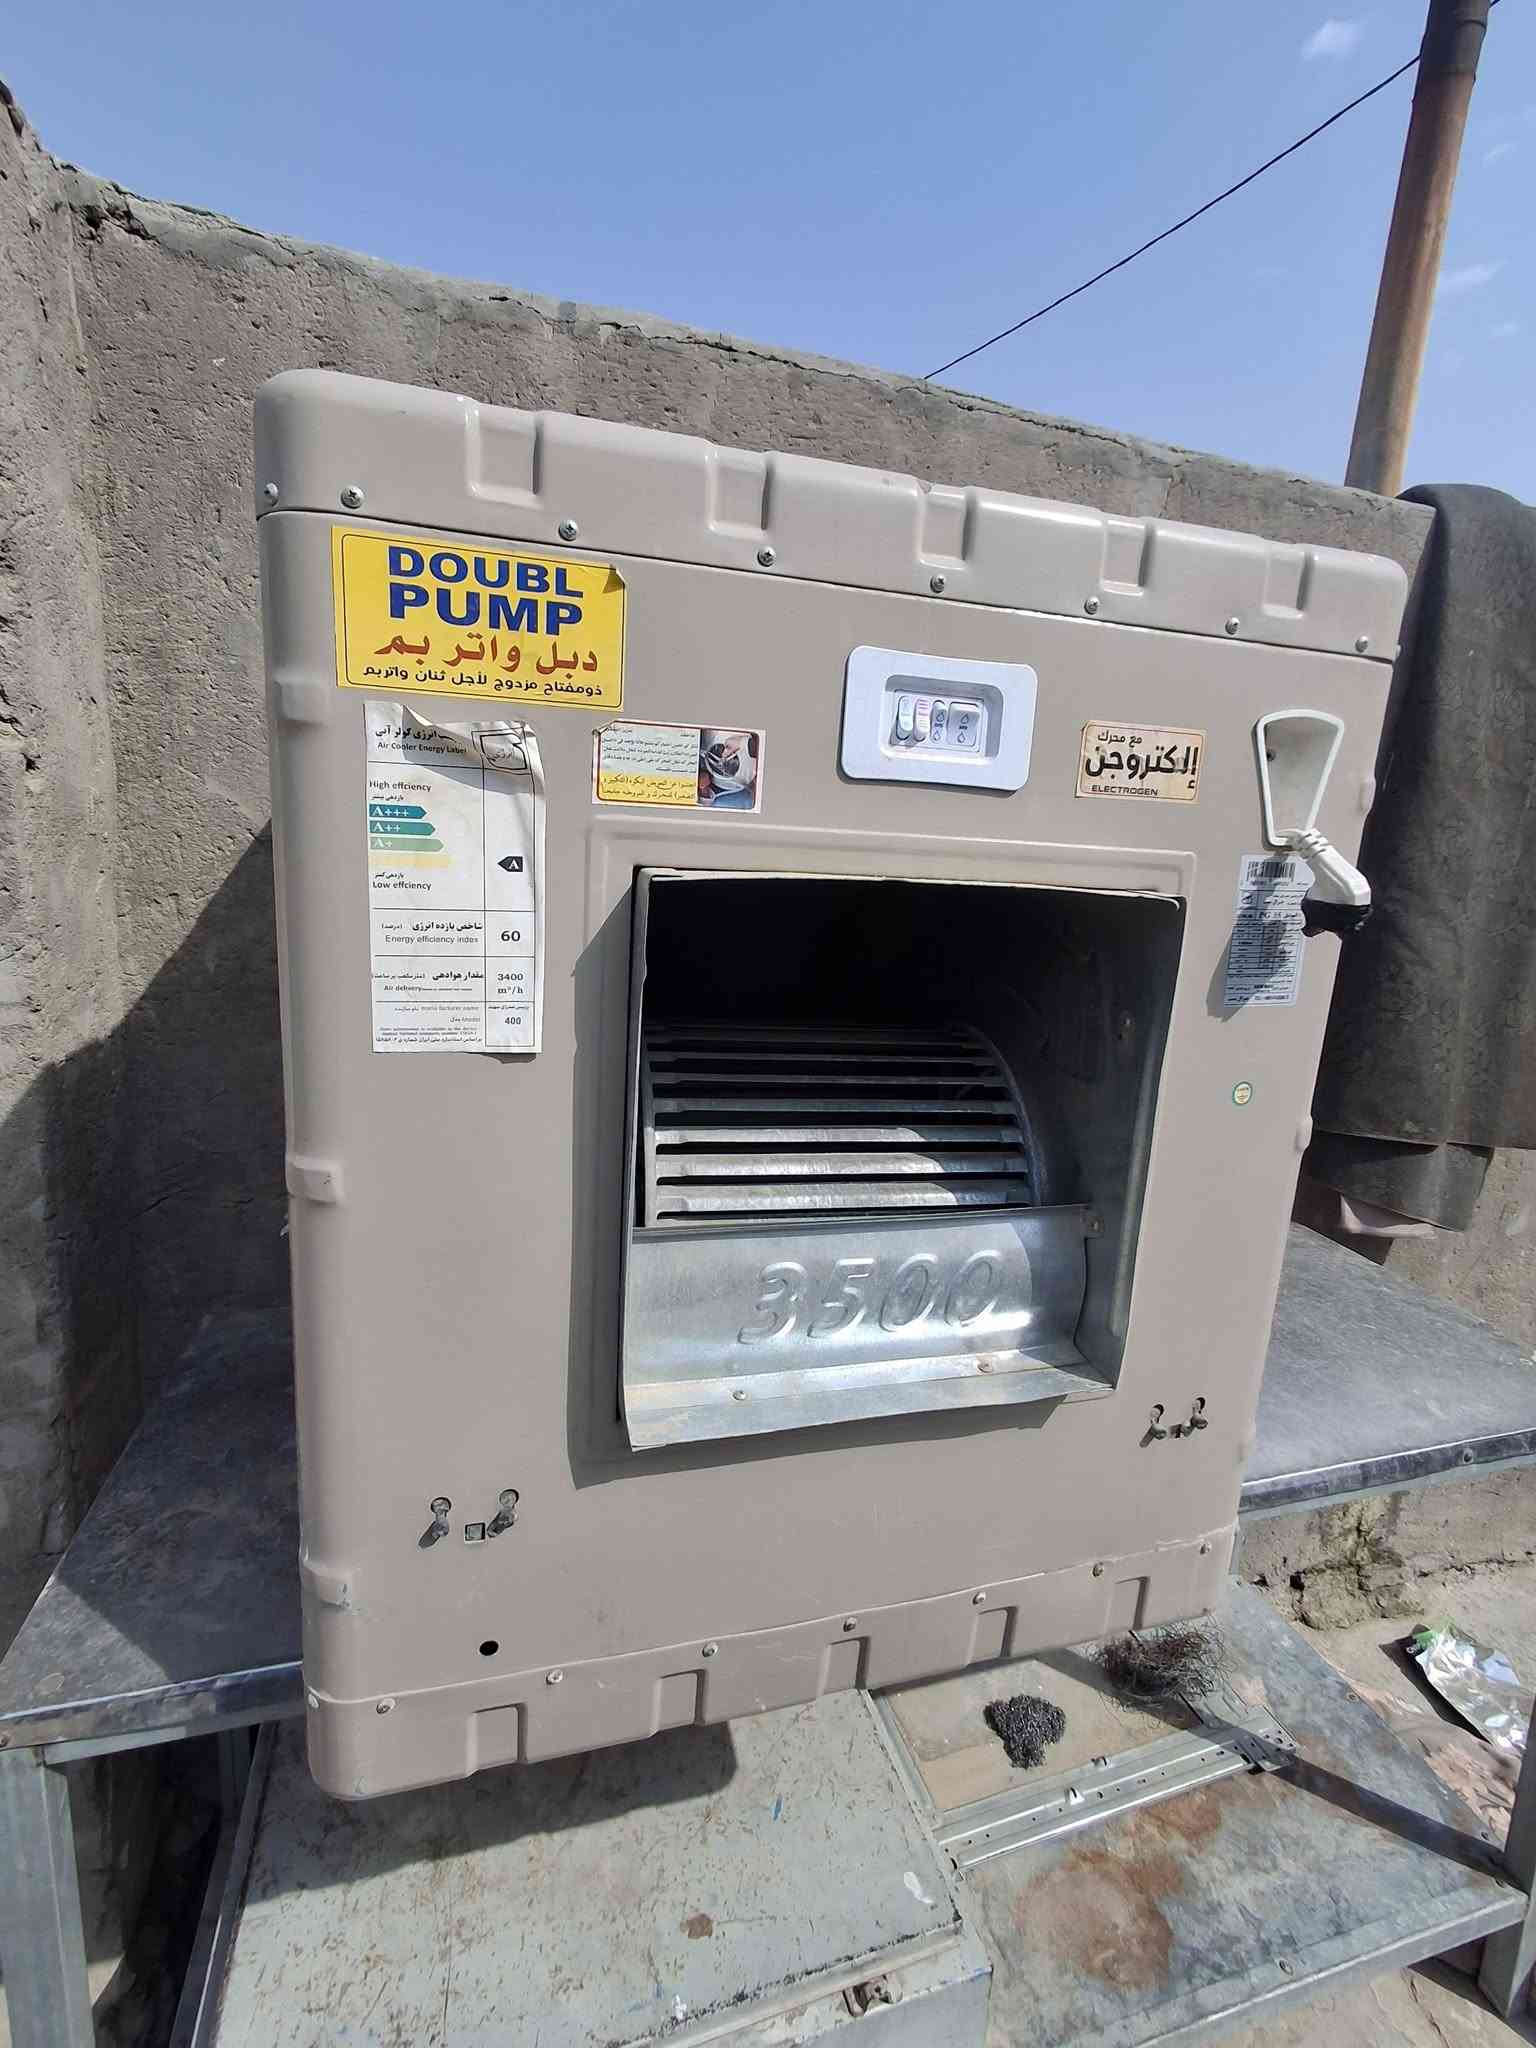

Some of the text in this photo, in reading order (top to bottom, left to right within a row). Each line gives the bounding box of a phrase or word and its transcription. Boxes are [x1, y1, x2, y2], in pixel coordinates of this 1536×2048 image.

[388, 545, 584, 599] DOUBL
[389, 582, 583, 636] PUMP
[441, 631, 522, 674] واتر
[535, 640, 598, 680] دبل
[391, 742, 417, 751] Cooler
[419, 743, 446, 754] Energy
[369, 780, 390, 790] High
[1091, 784, 1158, 796] ELECTROGEN
[372, 805, 409, 817] A+++
[372, 821, 400, 832] A++
[373, 837, 393, 848] A+
[509, 859, 519, 870] A
[372, 881, 391, 889] Low
[385, 934, 415, 945] Energy
[457, 935, 479, 943] index
[500, 930, 521, 943] 60
[496, 973, 524, 981] 3400
[504, 1016, 522, 1025] 400
[737, 1249, 1001, 1345] 3500
